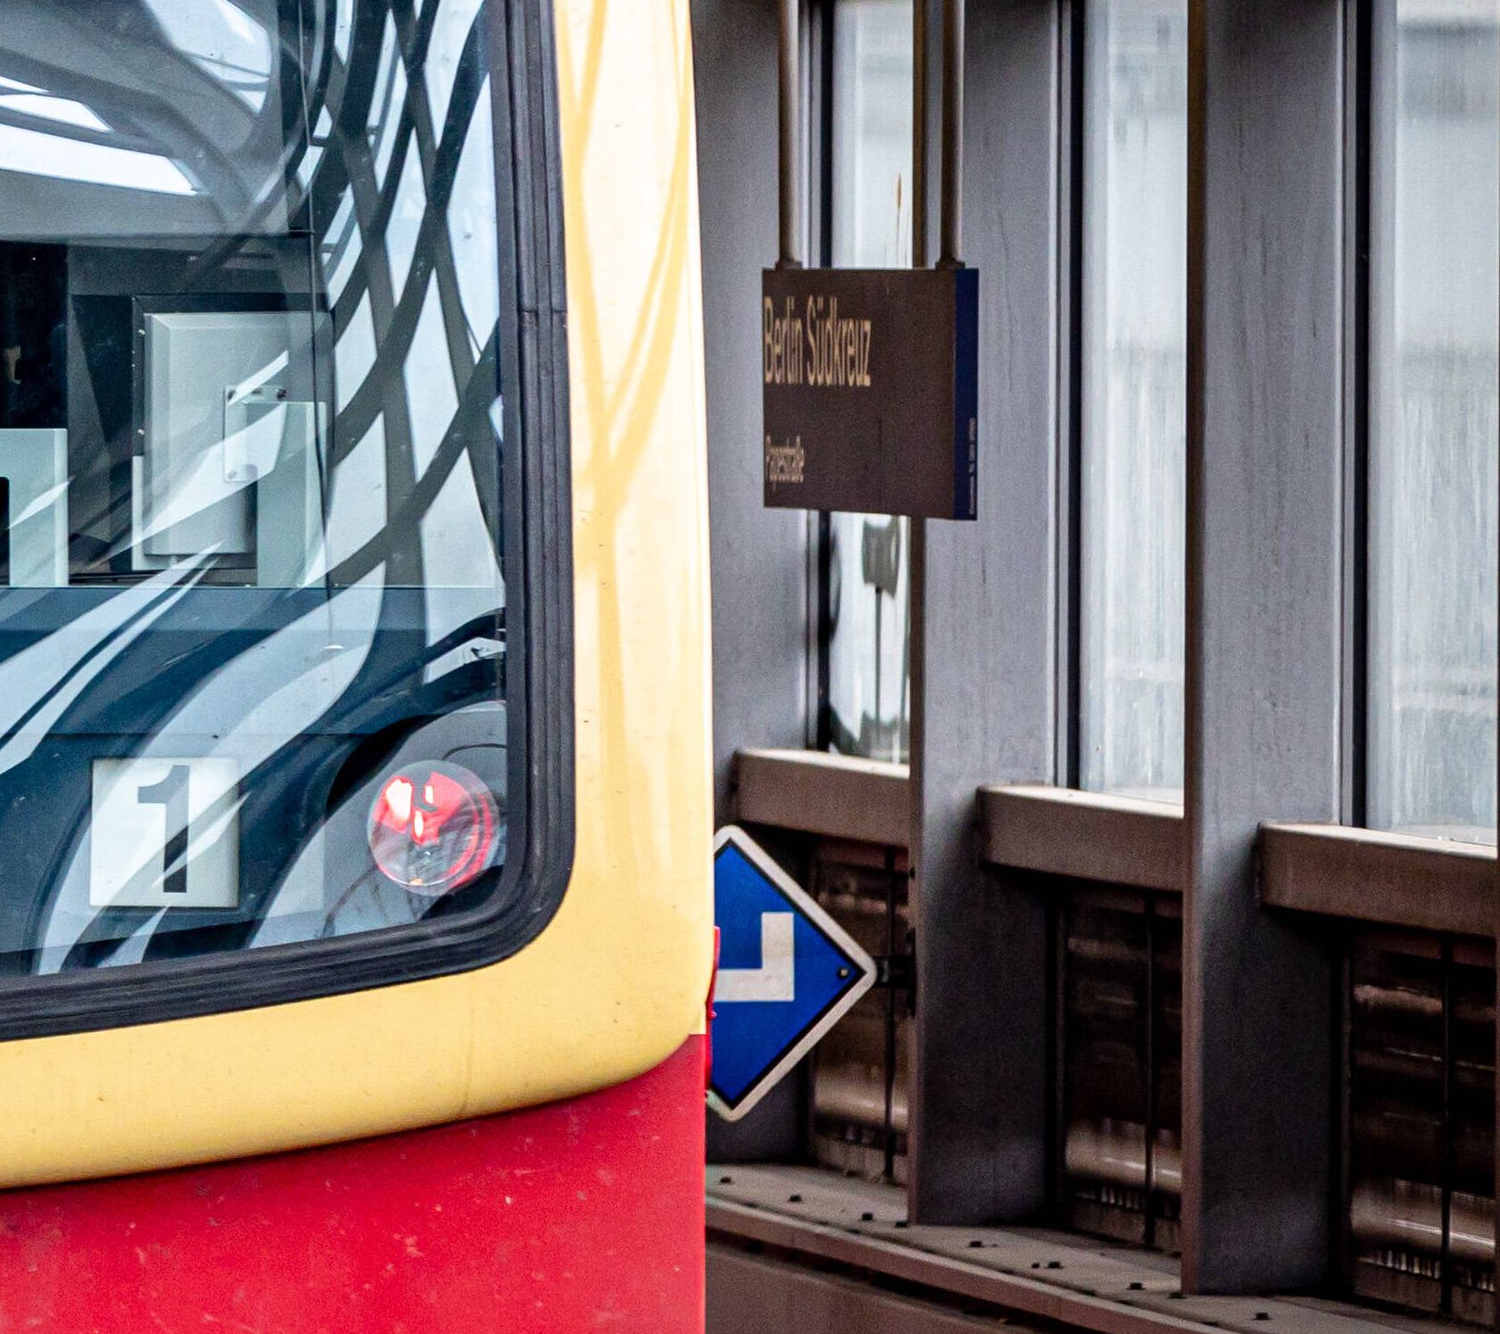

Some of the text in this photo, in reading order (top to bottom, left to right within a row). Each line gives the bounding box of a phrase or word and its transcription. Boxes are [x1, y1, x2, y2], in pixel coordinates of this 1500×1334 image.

[764, 294, 871, 387] Berlin Südkreuz
[137, 765, 190, 893] 1
